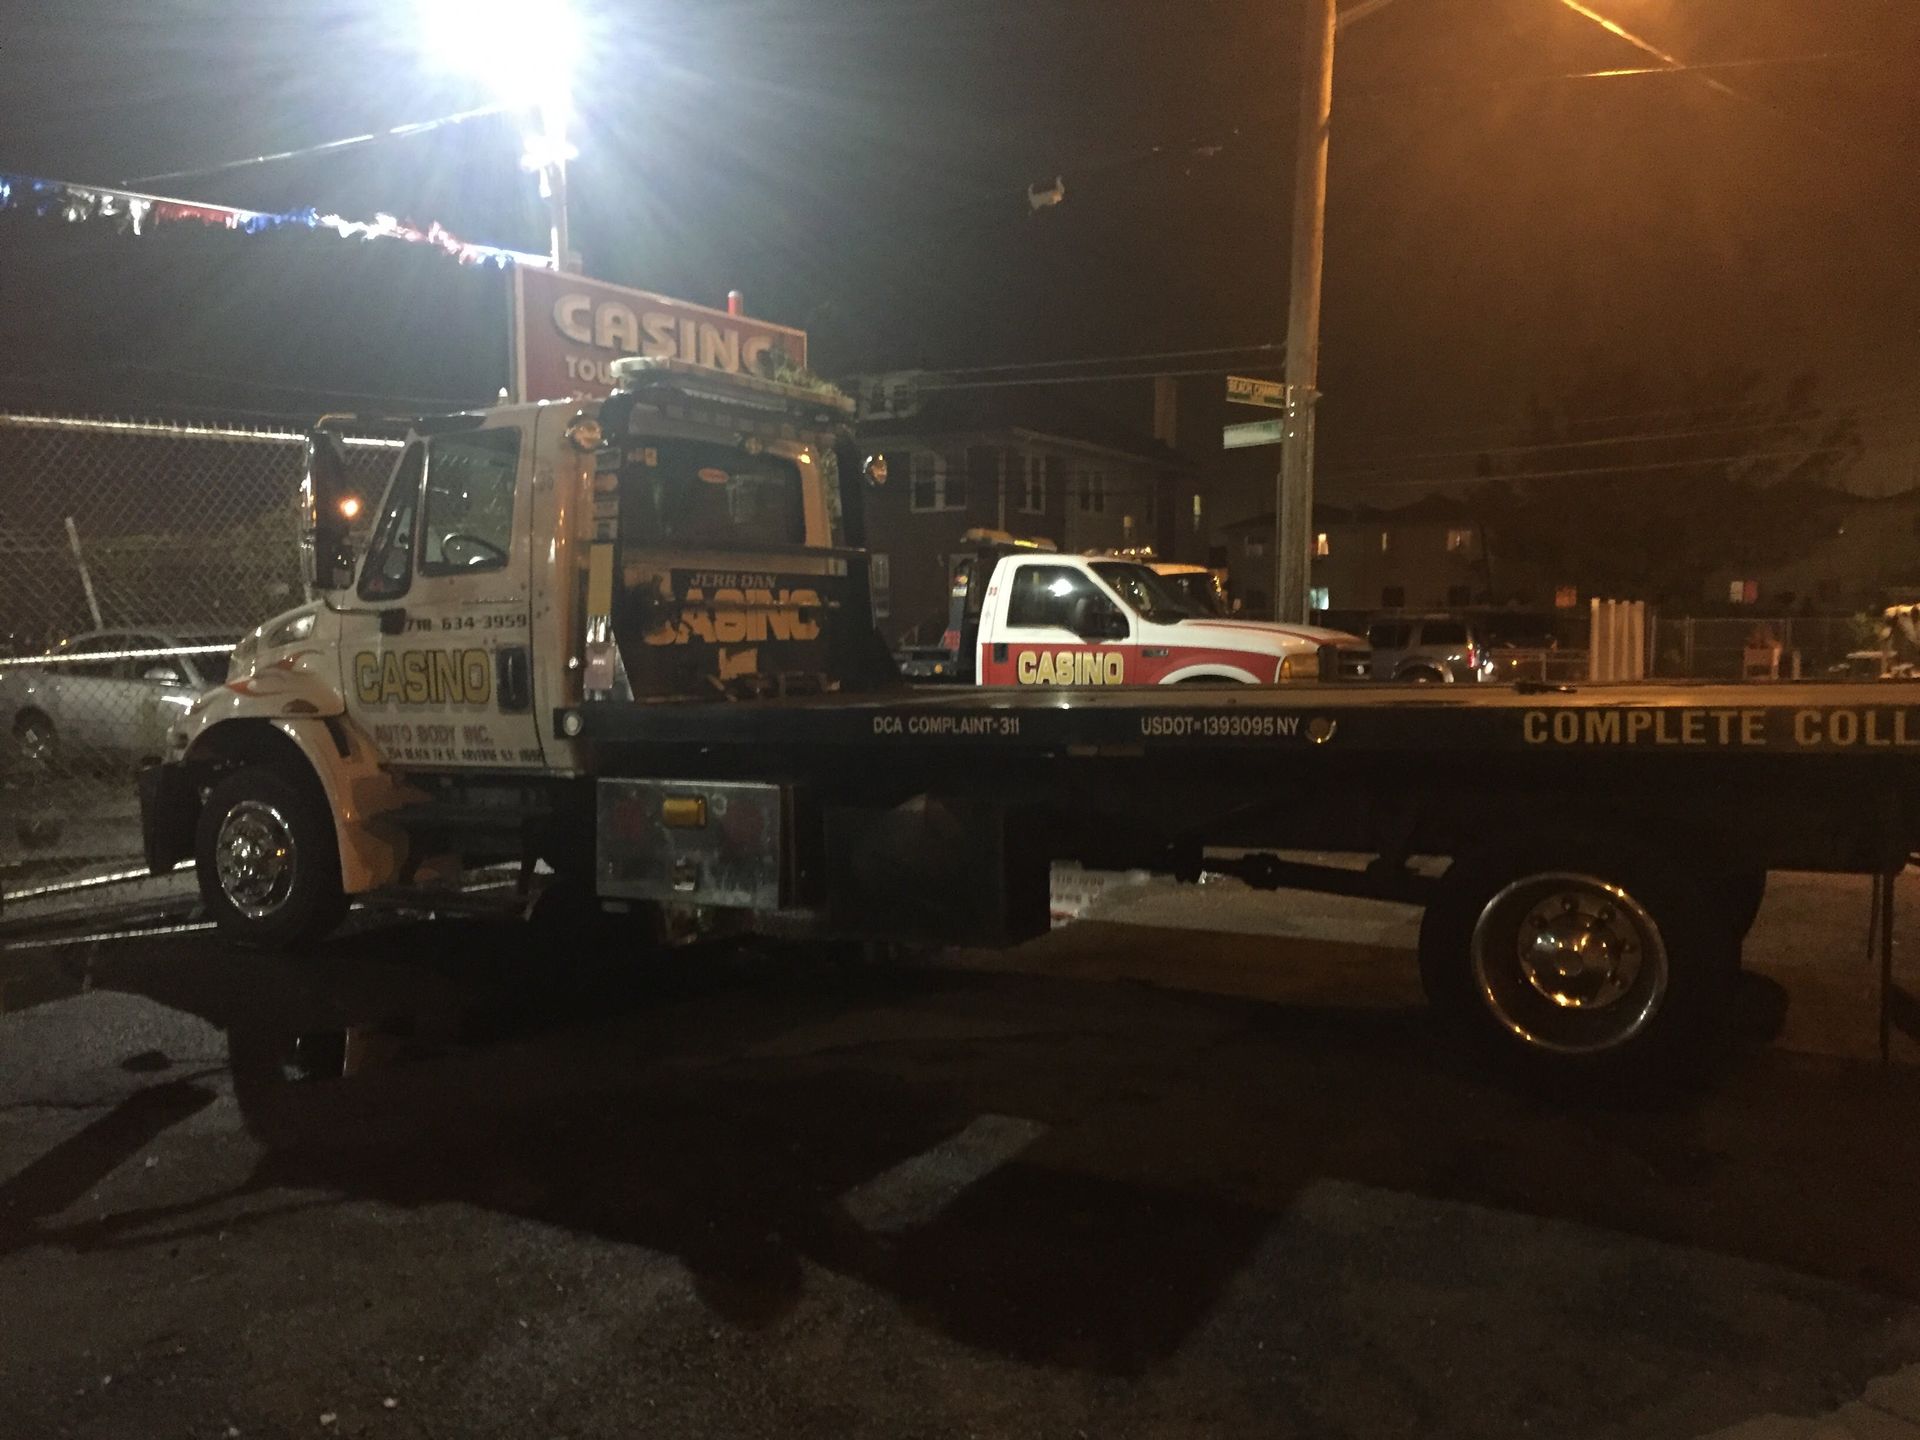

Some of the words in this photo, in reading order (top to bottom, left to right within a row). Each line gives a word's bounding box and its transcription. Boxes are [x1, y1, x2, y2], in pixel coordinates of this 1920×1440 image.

[355, 648, 491, 705] CASINO
[1018, 650, 1124, 685] CASINO
[873, 716, 903, 734] DCA
[1523, 710, 1767, 745] COMPLETE
[1794, 709, 1920, 746] COLL
